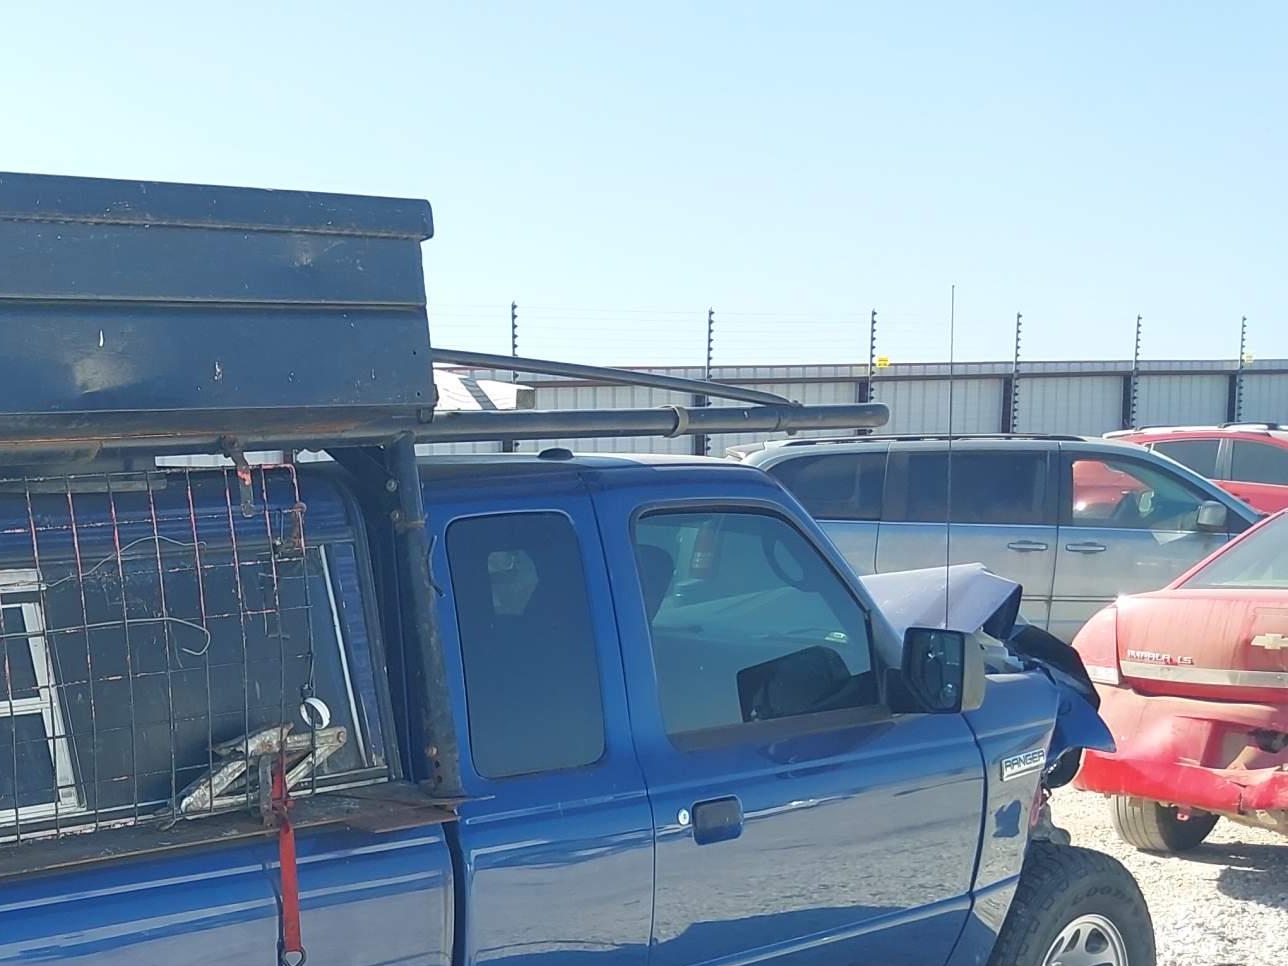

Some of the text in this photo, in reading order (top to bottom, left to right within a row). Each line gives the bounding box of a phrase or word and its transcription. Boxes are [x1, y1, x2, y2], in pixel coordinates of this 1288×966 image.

[1127, 649, 1194, 664] IMPALA LS
[1004, 750, 1045, 771] RANGER
